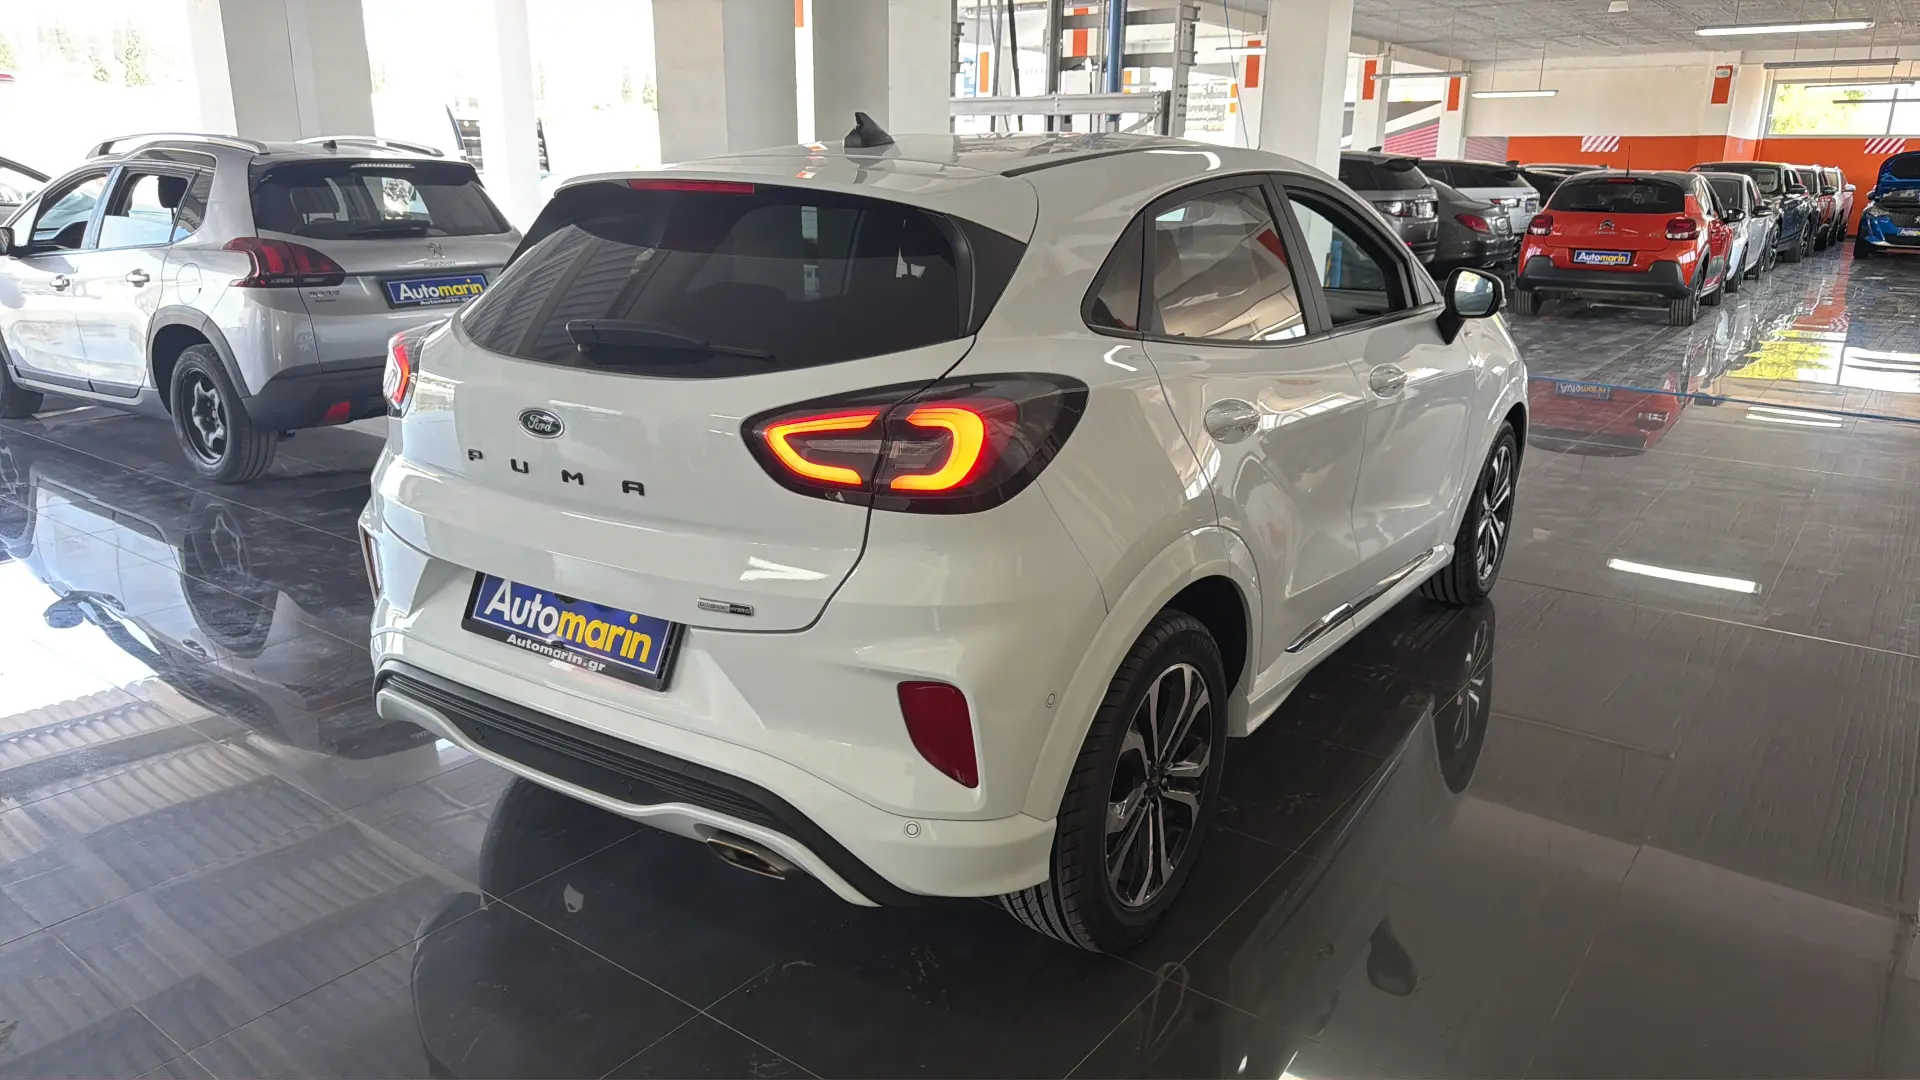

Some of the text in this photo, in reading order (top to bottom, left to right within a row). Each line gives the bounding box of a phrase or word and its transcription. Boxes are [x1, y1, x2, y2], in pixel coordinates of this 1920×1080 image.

[1578, 251, 1626, 263] Automarin
[400, 278, 484, 301] Automarin
[528, 413, 557, 433] Ford
[467, 448, 645, 496] PUMA
[484, 579, 652, 663] Automarin
[506, 633, 606, 673] Automarin.gr
